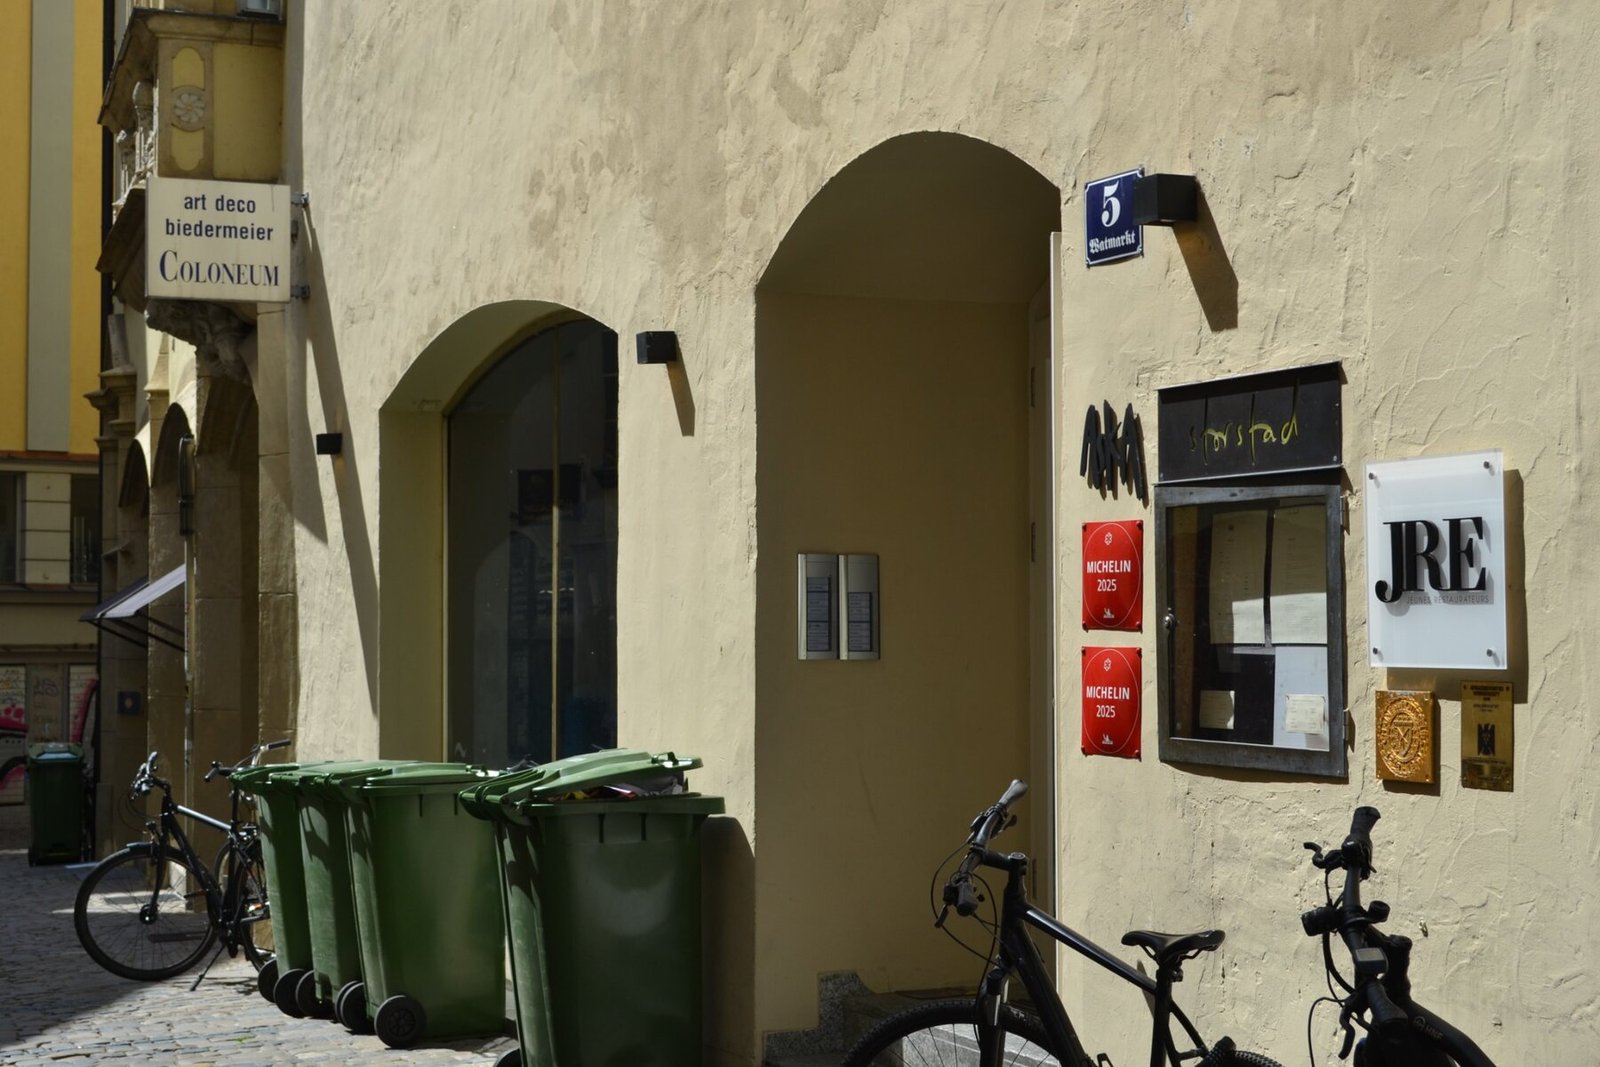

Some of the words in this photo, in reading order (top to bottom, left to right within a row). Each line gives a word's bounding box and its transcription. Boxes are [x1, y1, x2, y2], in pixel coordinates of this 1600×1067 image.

[184, 194, 206, 210] art
[215, 195, 256, 213] deco
[1101, 180, 1121, 228] 5
[165, 218, 273, 241] biedermeier
[1089, 230, 1136, 255] Watmarkt
[159, 249, 280, 287] COLONEUM
[1189, 384, 1299, 466] storstad
[1086, 559, 1132, 573] MICHELIN
[1375, 516, 1487, 604] JRE
[1097, 579, 1117, 592] 2025
[1407, 595, 1432, 605] JEUNES
[1434, 594, 1490, 604] RESTAURATEURS
[1086, 685, 1130, 700] MICHELIN
[1096, 705, 1116, 718] 2025
